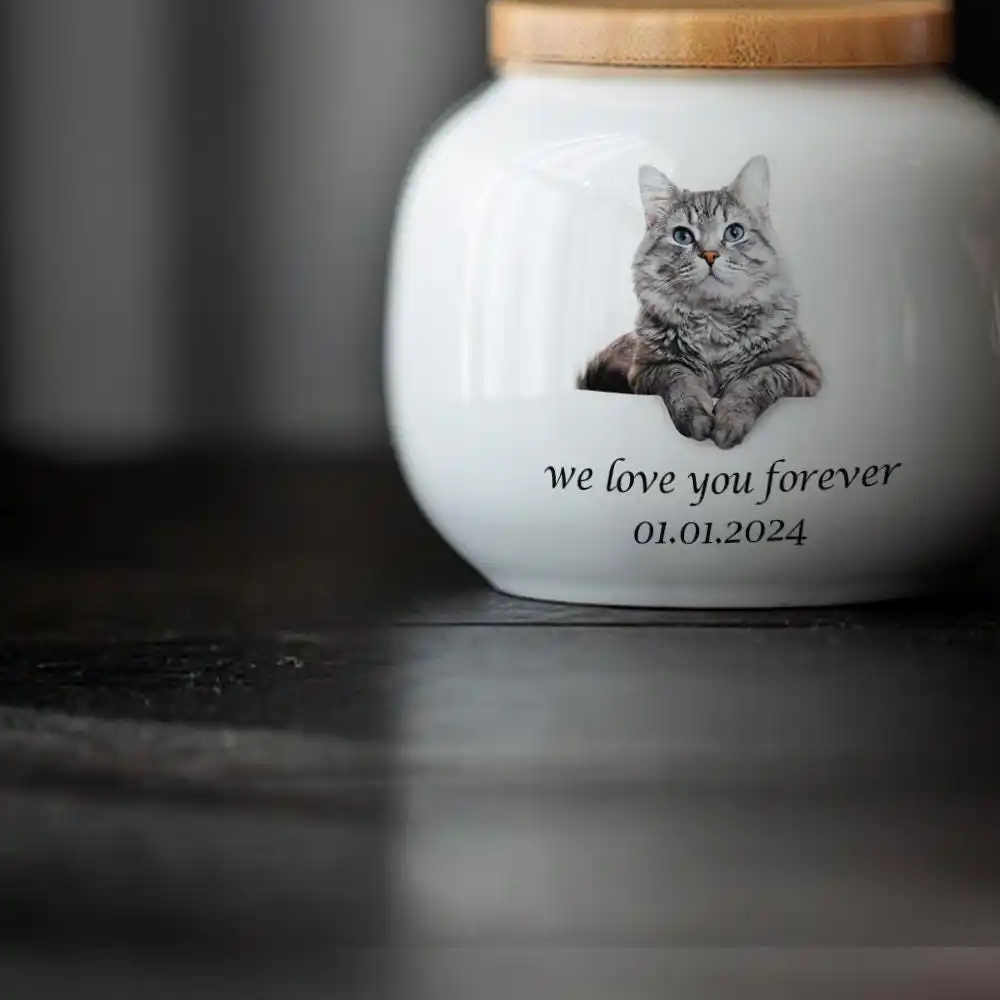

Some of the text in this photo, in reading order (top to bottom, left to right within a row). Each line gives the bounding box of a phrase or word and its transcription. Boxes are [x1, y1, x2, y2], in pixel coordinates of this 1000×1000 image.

[543, 457, 902, 507] we love you forever
[632, 518, 808, 547] 01.01.2024
